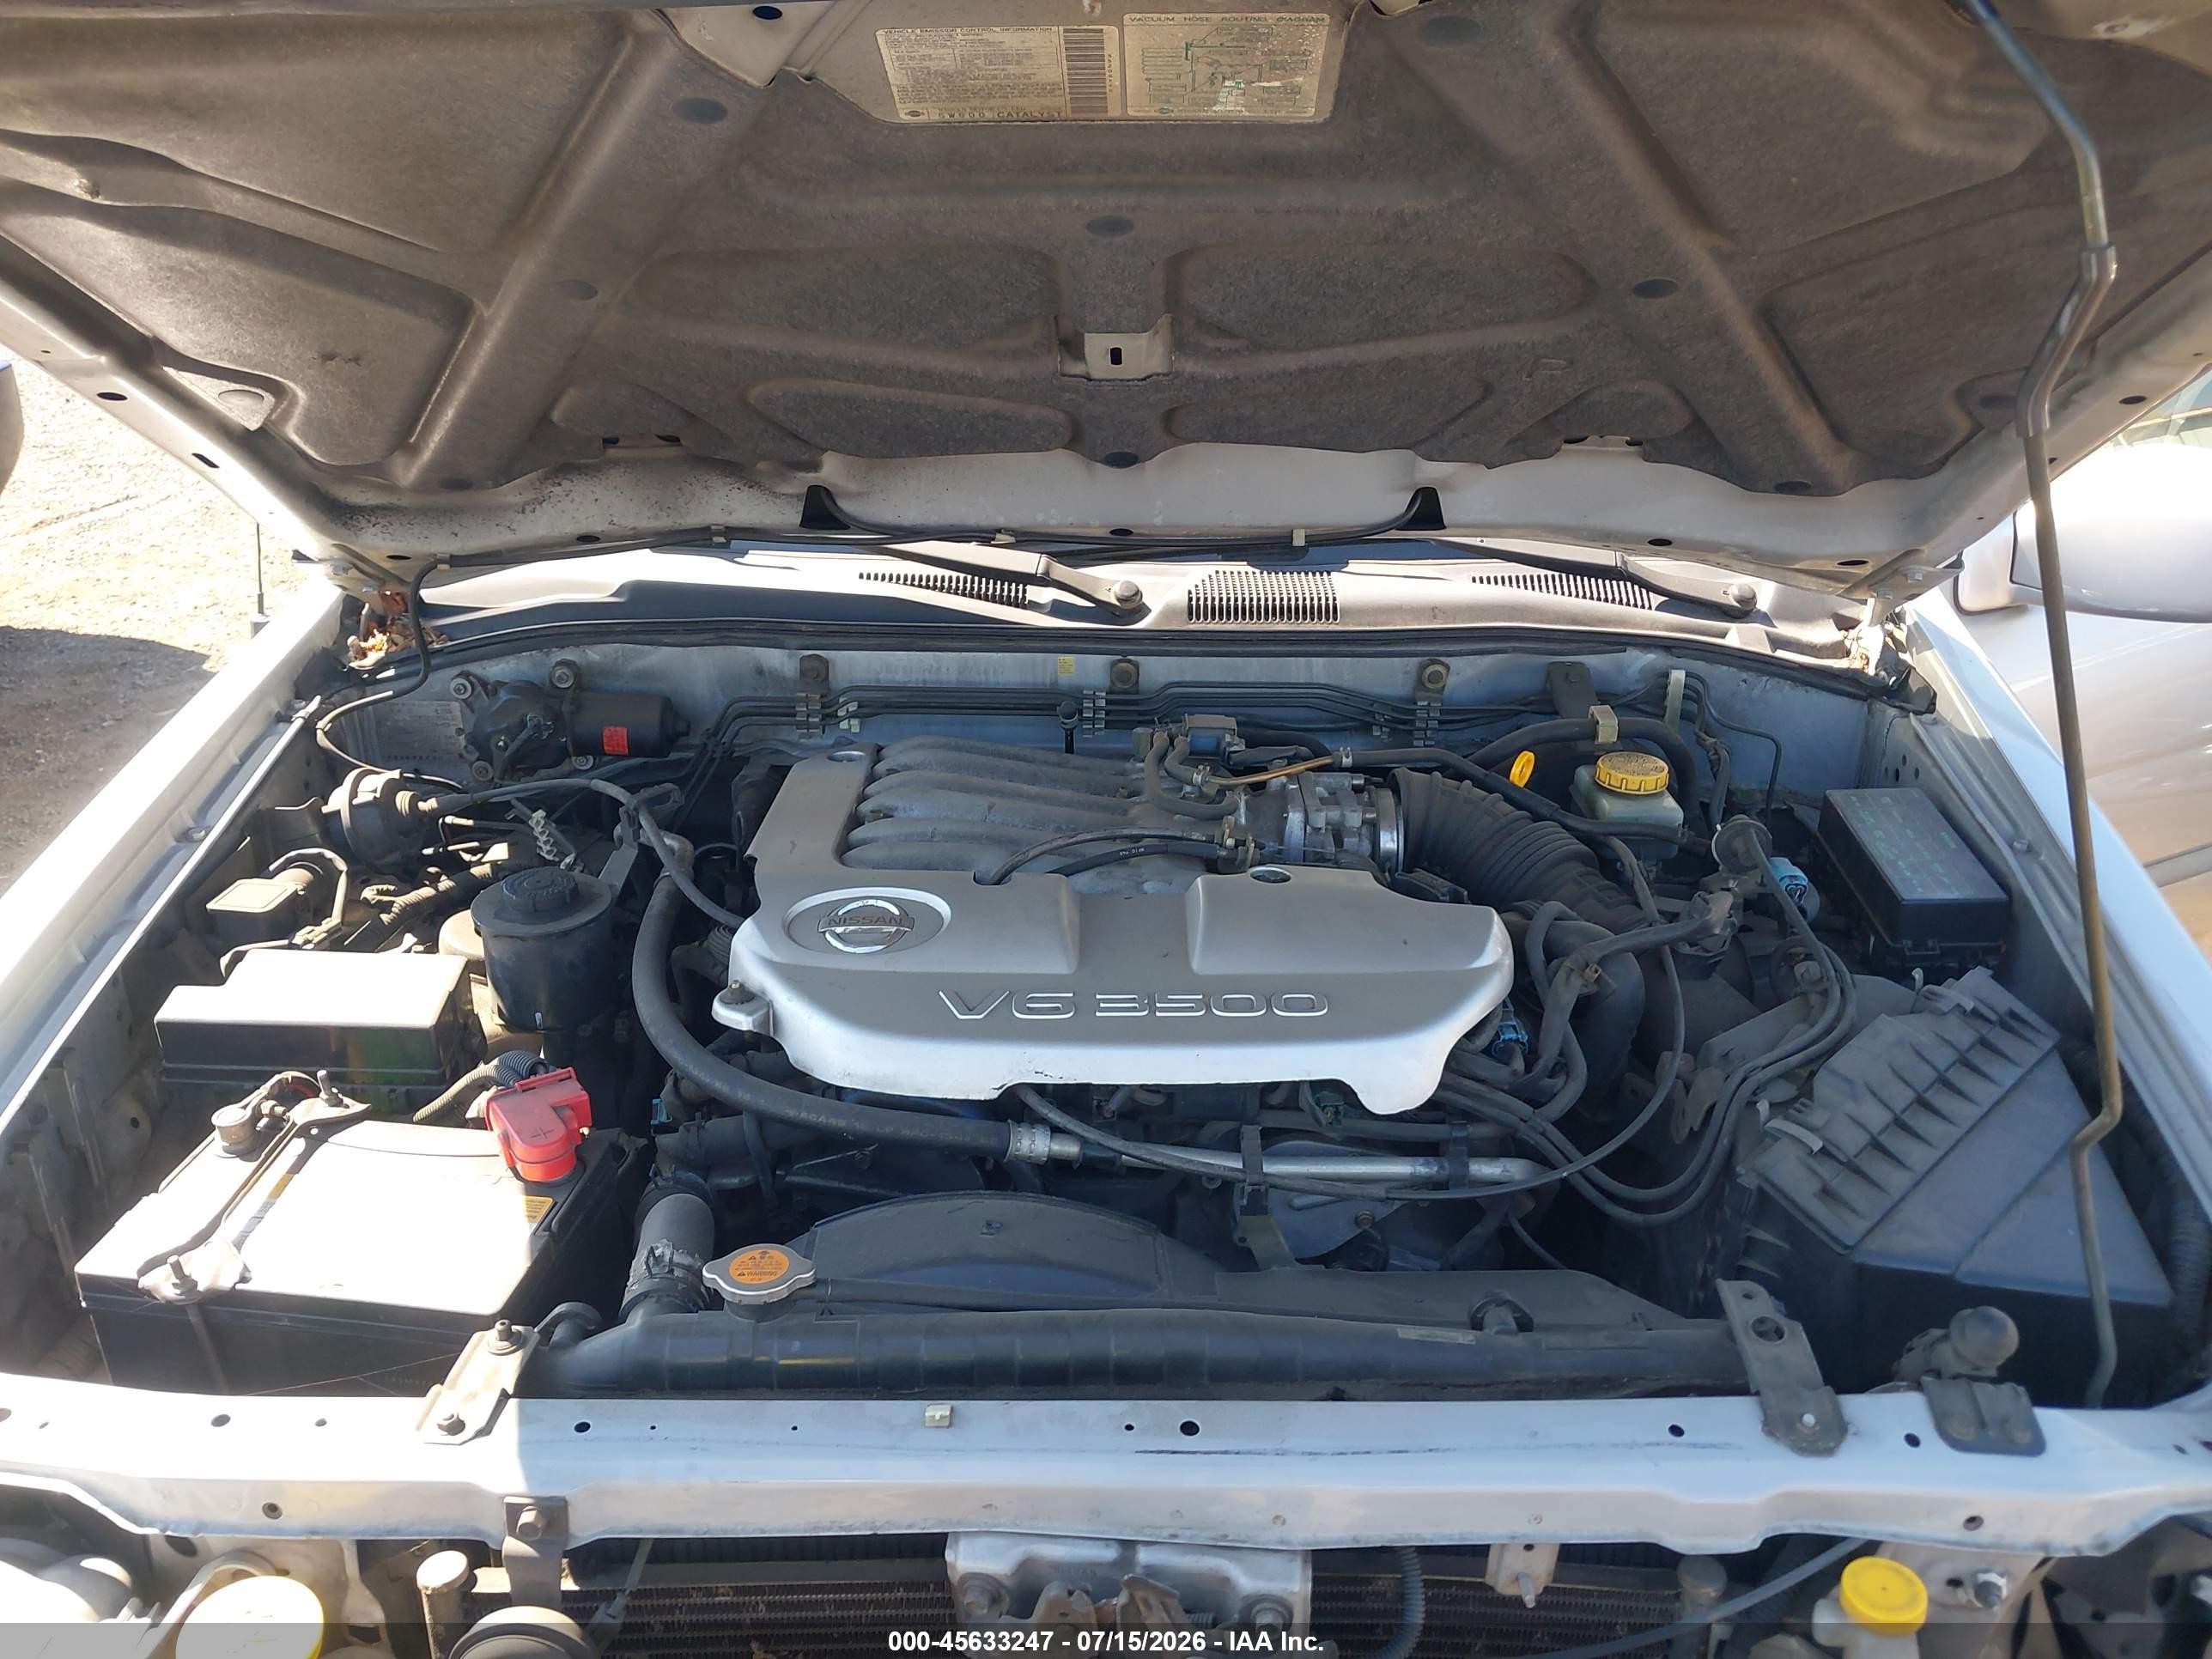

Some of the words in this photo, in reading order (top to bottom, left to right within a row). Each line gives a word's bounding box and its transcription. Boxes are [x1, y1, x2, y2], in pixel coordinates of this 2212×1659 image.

[828, 915, 902, 926] NISSAN
[938, 990, 1076, 1020] V6
[1095, 992, 1328, 1018] 3500
